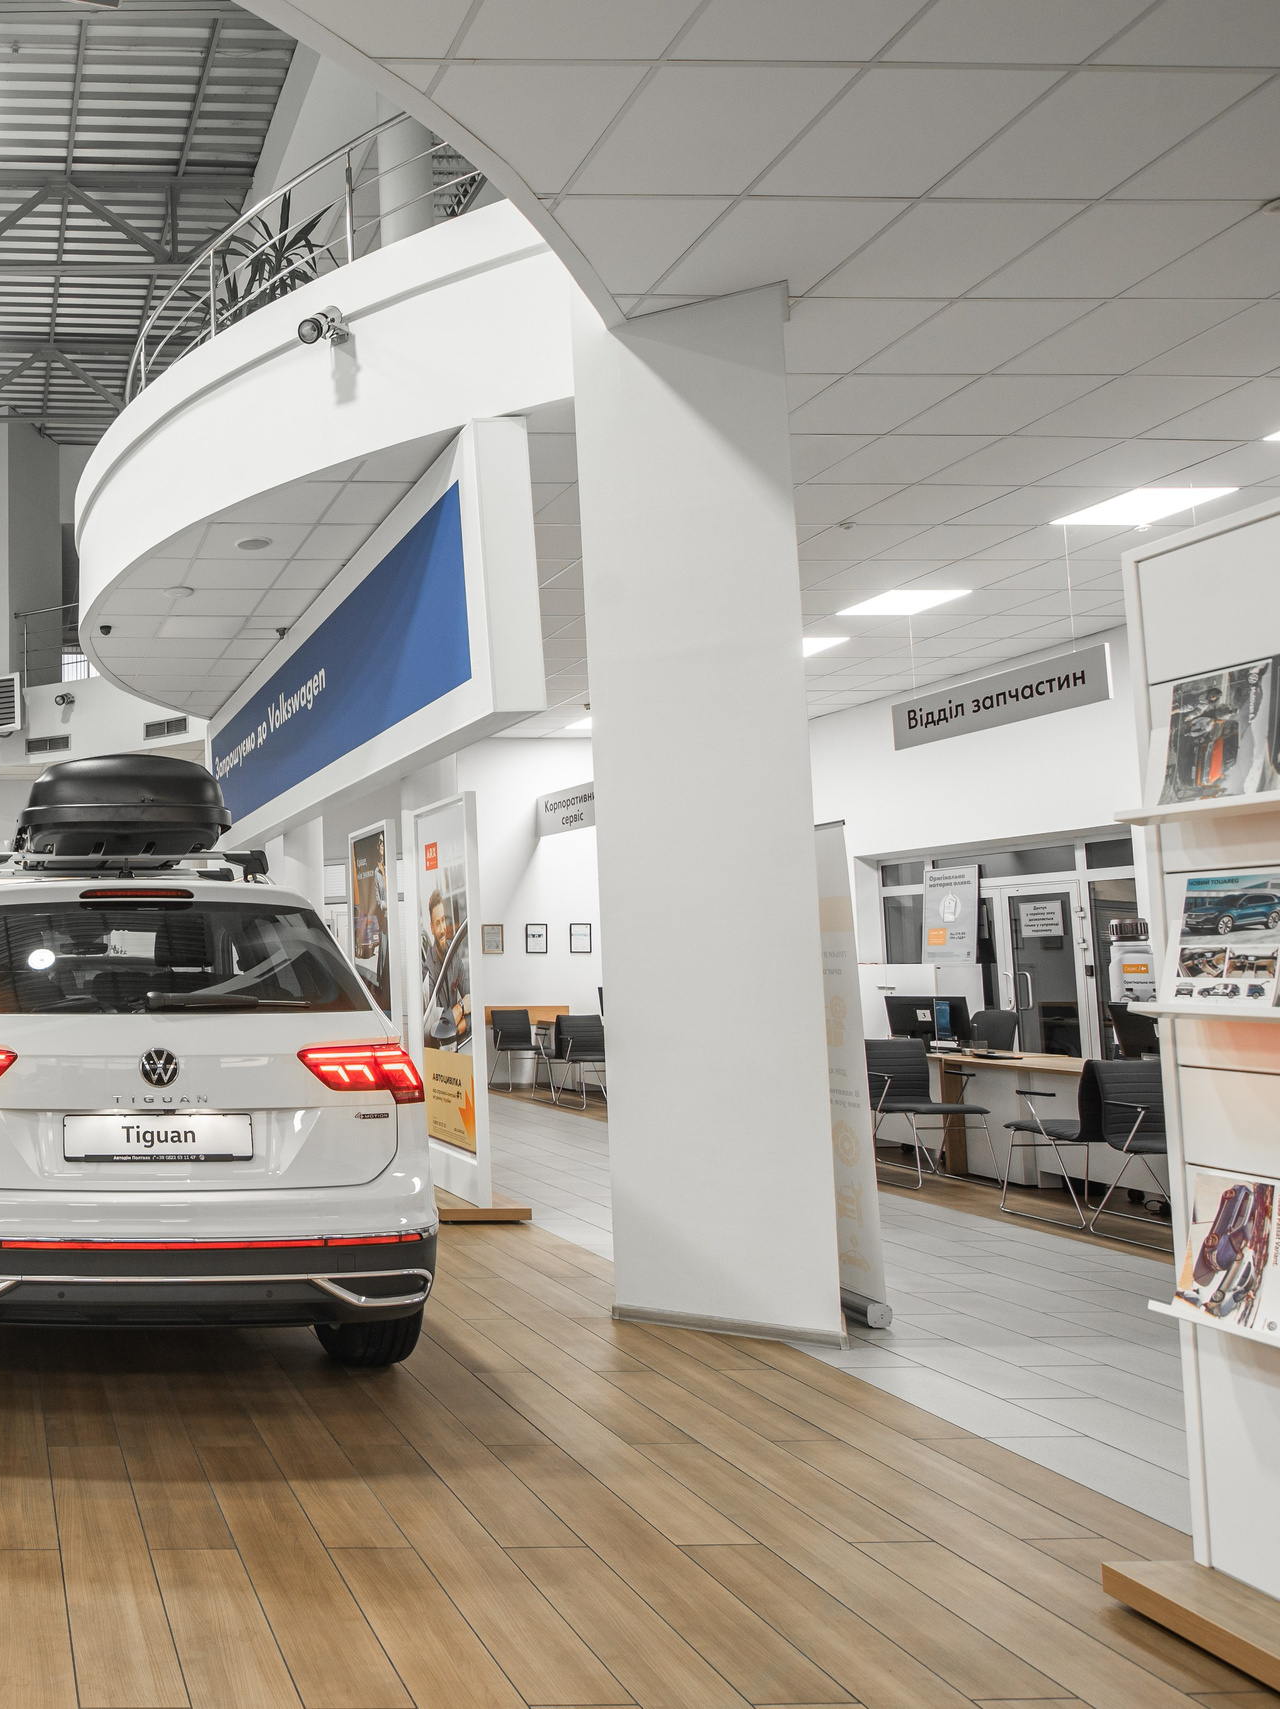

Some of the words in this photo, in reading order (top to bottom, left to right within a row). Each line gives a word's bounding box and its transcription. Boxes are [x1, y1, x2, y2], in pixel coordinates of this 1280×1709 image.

[907, 699, 965, 729] Відділ
[972, 669, 1086, 713] запчастин
[214, 731, 256, 780] Запрошуємо
[257, 721, 267, 748] до
[267, 667, 326, 733] Volkswagen
[561, 809, 584, 827] сервіс
[928, 874, 966, 882] Оригінальна
[112, 1094, 208, 1104] TIGUAN
[121, 1125, 196, 1148] Tiguan
